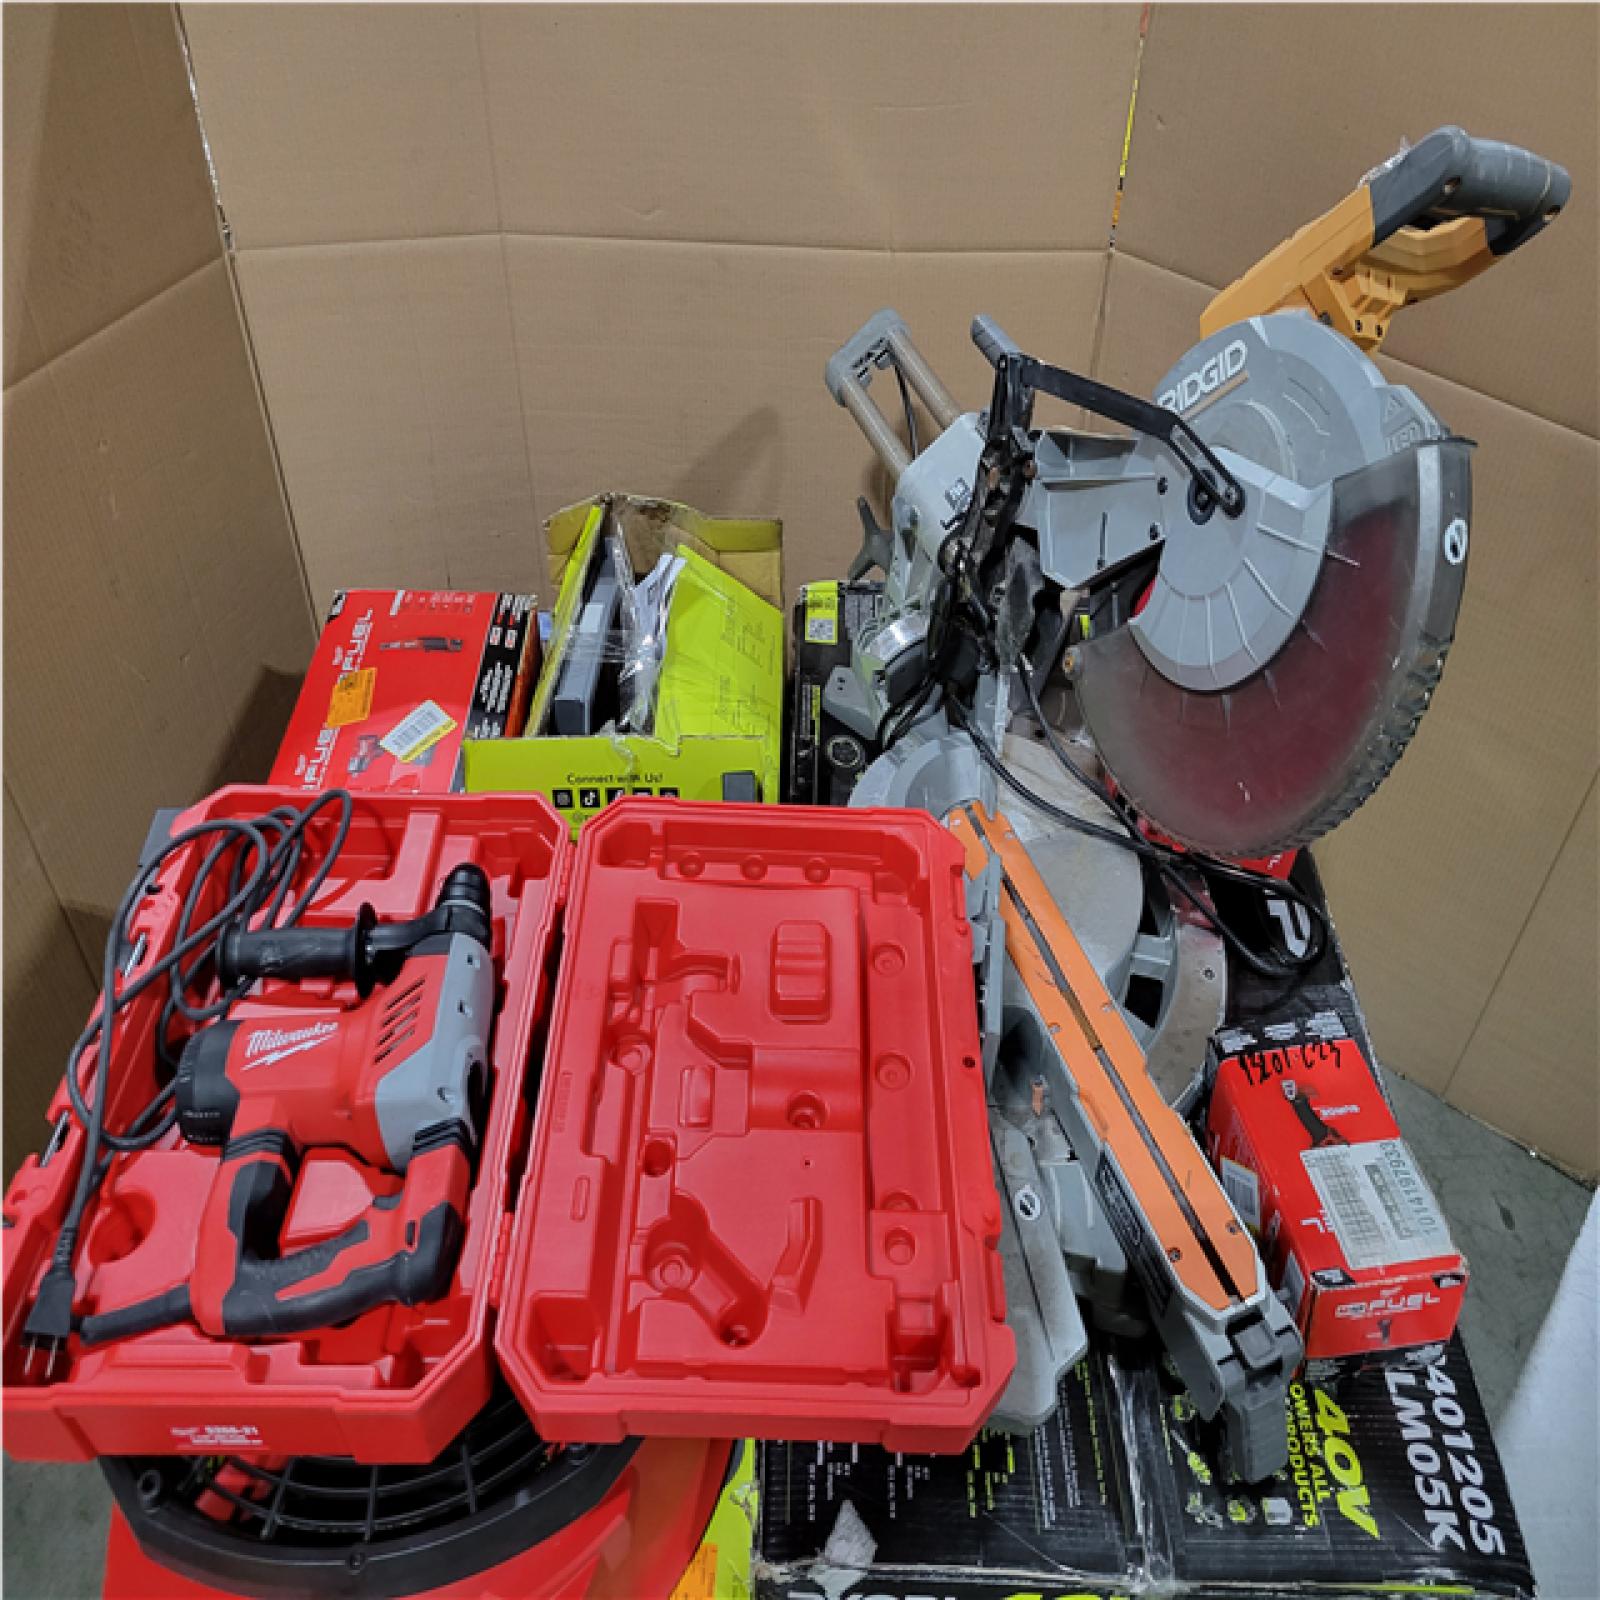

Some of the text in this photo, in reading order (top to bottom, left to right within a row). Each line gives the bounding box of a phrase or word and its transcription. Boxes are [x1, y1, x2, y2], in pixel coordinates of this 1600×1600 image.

[1156, 339, 1249, 413] RIDGID
[567, 772, 614, 785] Connect
[246, 1021, 339, 1059] Milwaukee
[1309, 1463, 1332, 1503] ALL
[1314, 1388, 1381, 1540] 40V
